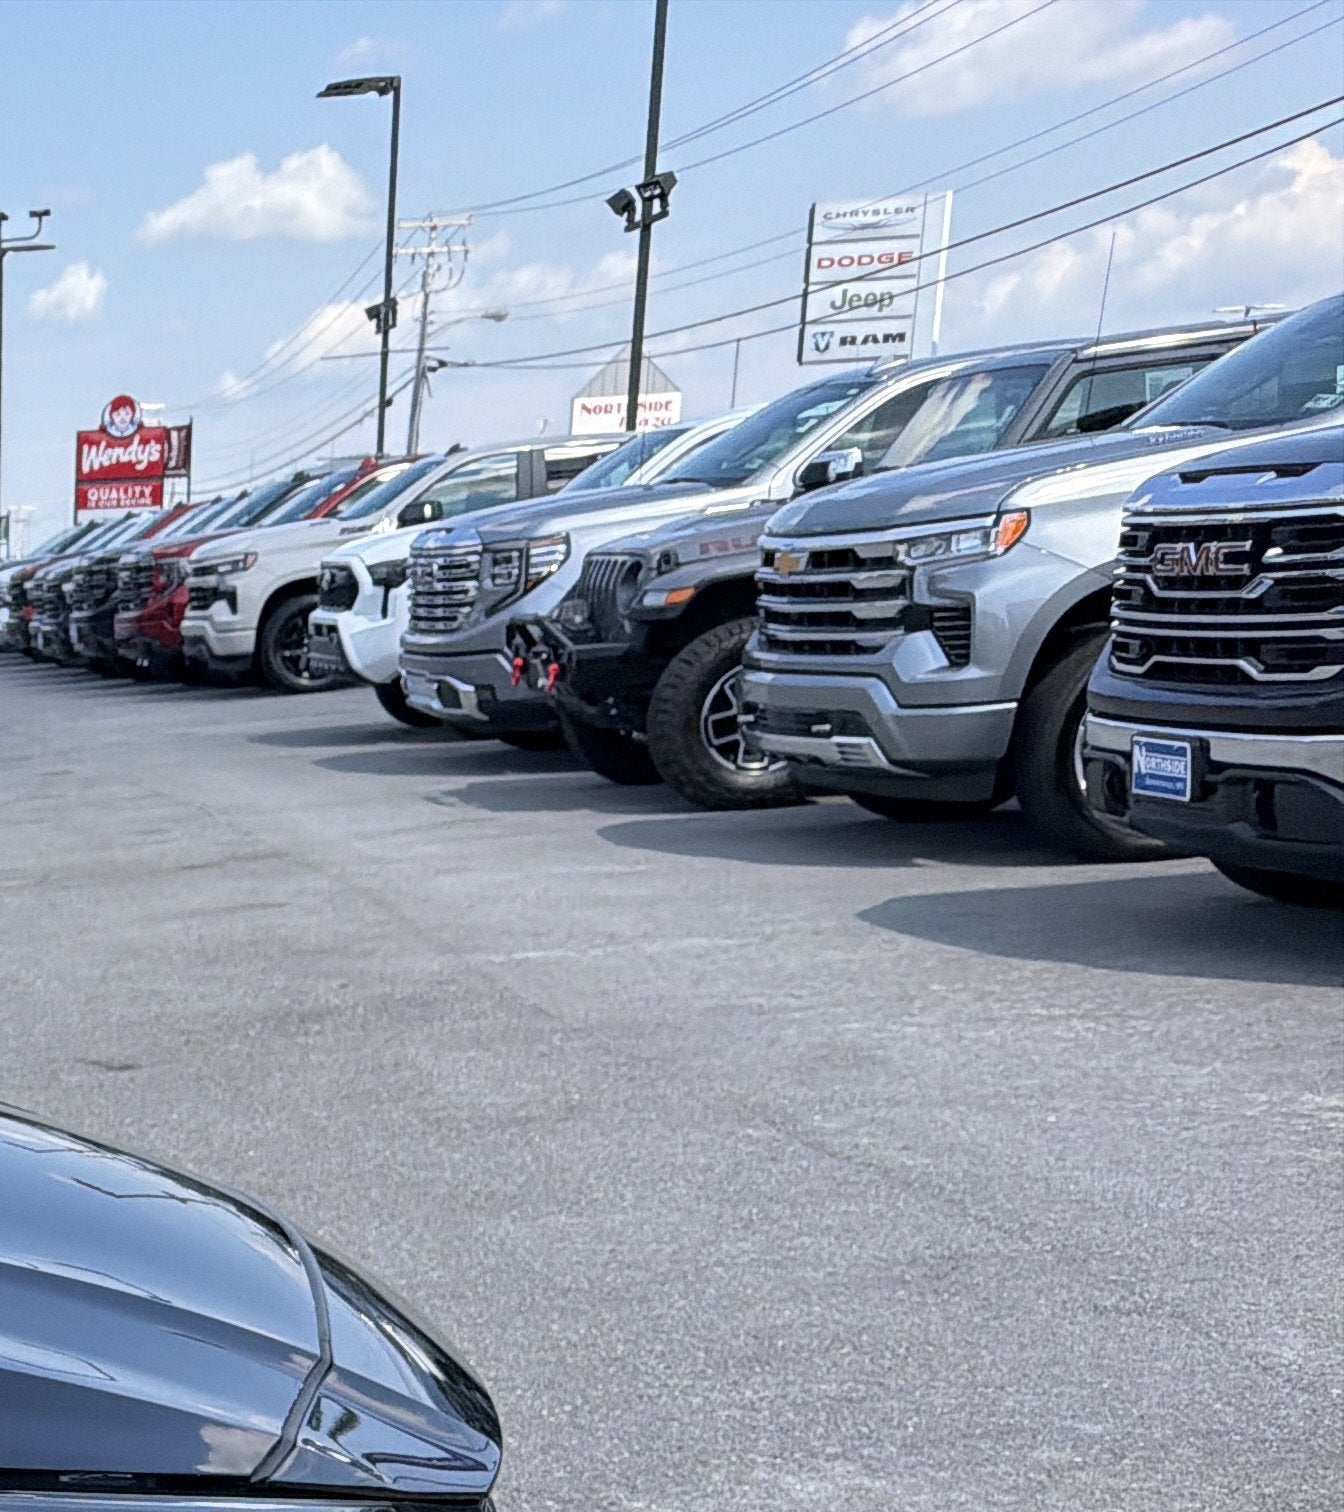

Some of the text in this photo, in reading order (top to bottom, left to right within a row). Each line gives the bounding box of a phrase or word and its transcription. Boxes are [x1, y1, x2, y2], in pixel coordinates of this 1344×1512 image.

[823, 206, 916, 220] CHRYSLER
[816, 251, 914, 270] DODGE
[830, 288, 894, 313] Jeep
[839, 332, 907, 347] RAM
[580, 400, 673, 416] NORTSIDE
[82, 433, 162, 475] Wendy's
[87, 484, 153, 501] QUALITY
[1152, 540, 1253, 576] GMC
